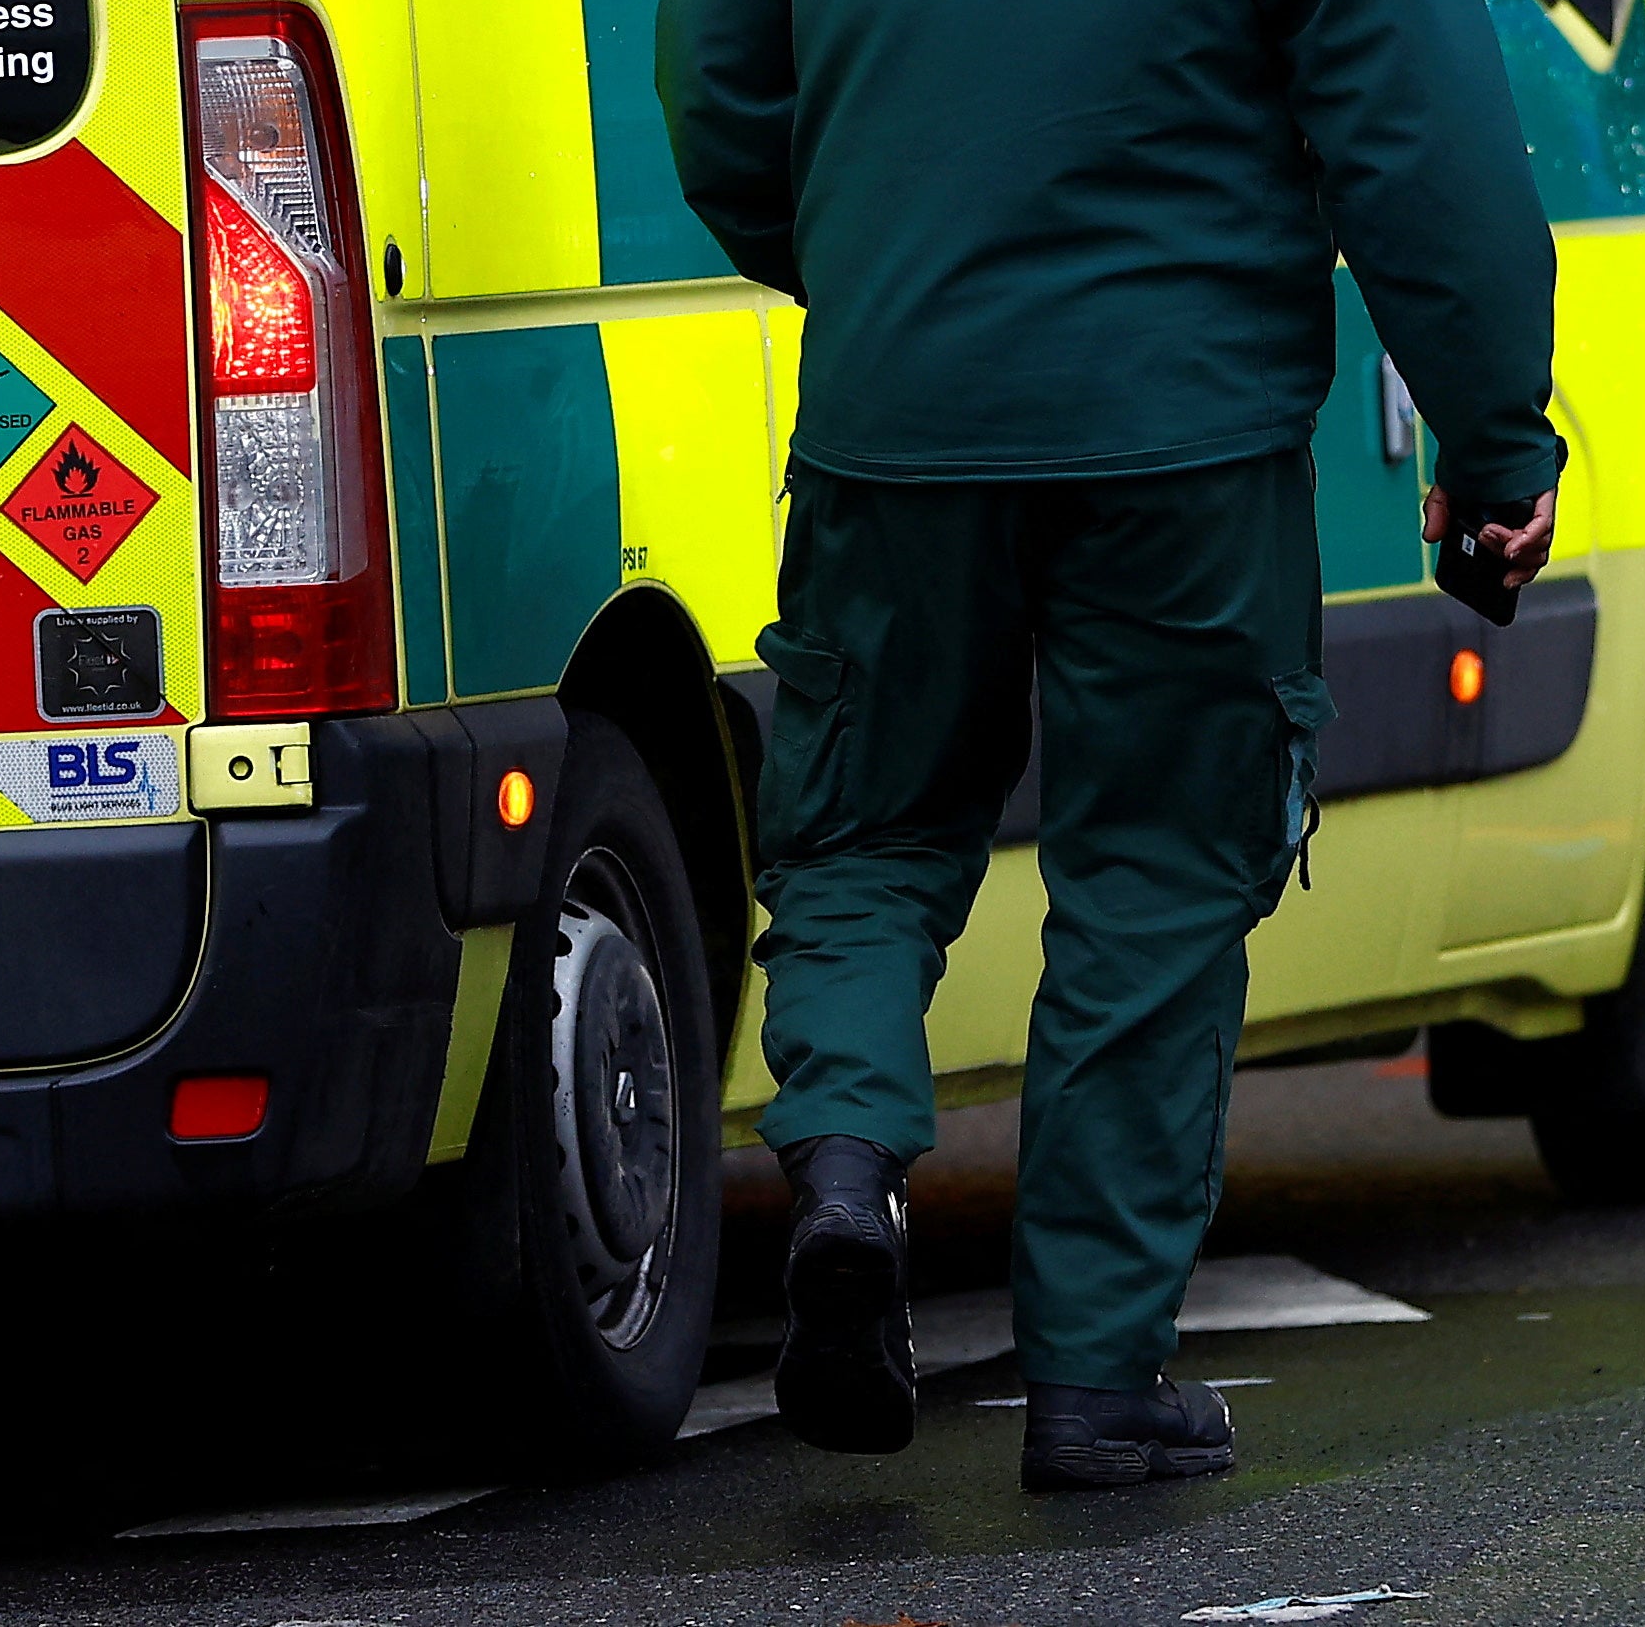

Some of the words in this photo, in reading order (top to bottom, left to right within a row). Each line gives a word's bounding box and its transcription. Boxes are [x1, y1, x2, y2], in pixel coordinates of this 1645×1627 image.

[21, 499, 136, 522] FLAMMABLE
[62, 525, 102, 541] GAS
[77, 547, 90, 565] 2
[126, 614, 139, 624] by
[48, 741, 141, 787] BLS
